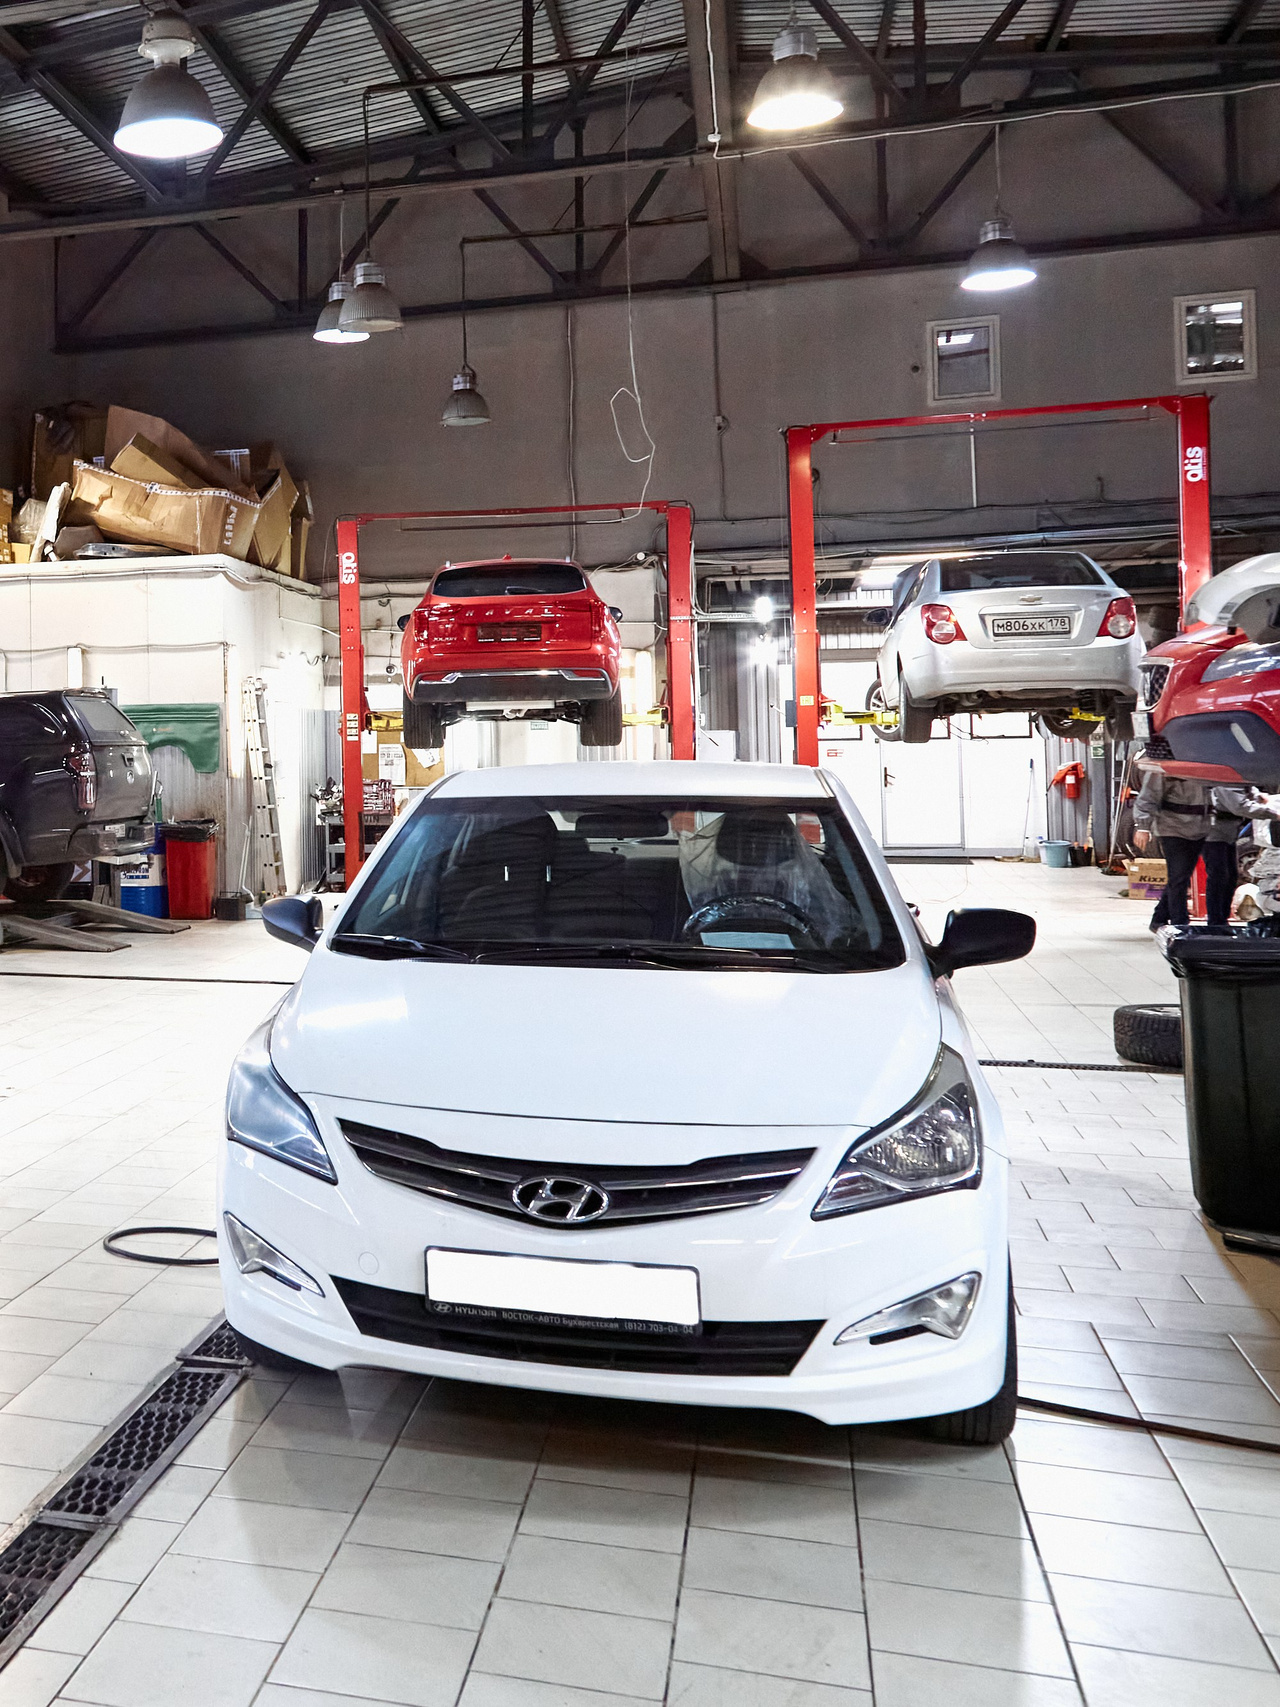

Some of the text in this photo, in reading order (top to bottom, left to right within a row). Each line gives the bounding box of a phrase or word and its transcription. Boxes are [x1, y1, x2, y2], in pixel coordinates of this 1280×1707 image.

[465, 607, 552, 617] HAVAL
[1048, 618, 1066, 627] 178
[502, 1310, 560, 1324] ВОСТОК-АВТО
